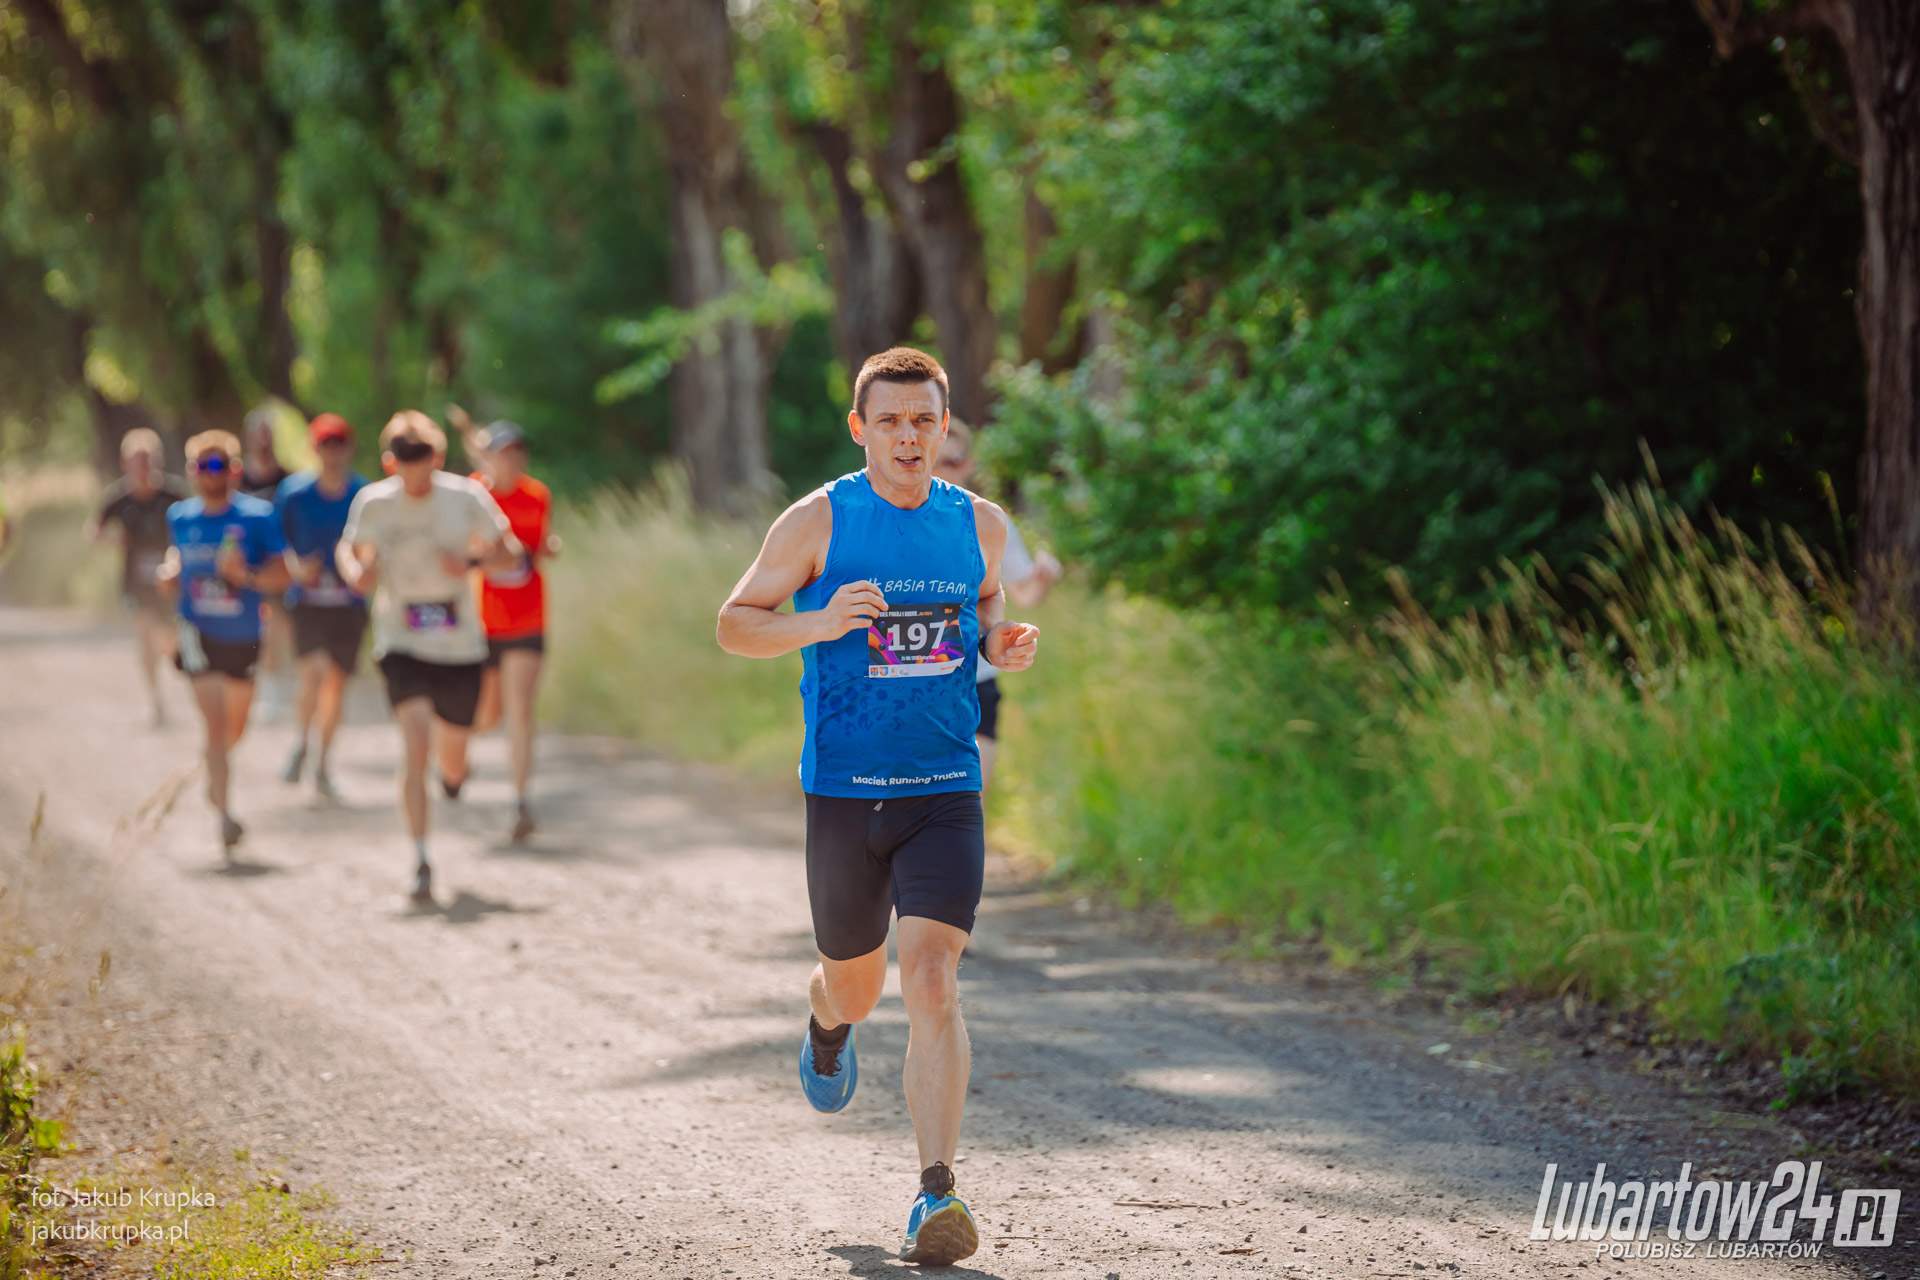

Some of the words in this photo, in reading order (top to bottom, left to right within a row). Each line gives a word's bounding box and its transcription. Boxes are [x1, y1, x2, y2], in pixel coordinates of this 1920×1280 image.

[884, 578, 925, 593] BASIA
[928, 579, 967, 595] TEAM
[887, 621, 946, 651] 197
[852, 775, 888, 787] Maciek
[889, 776, 932, 786] Running
